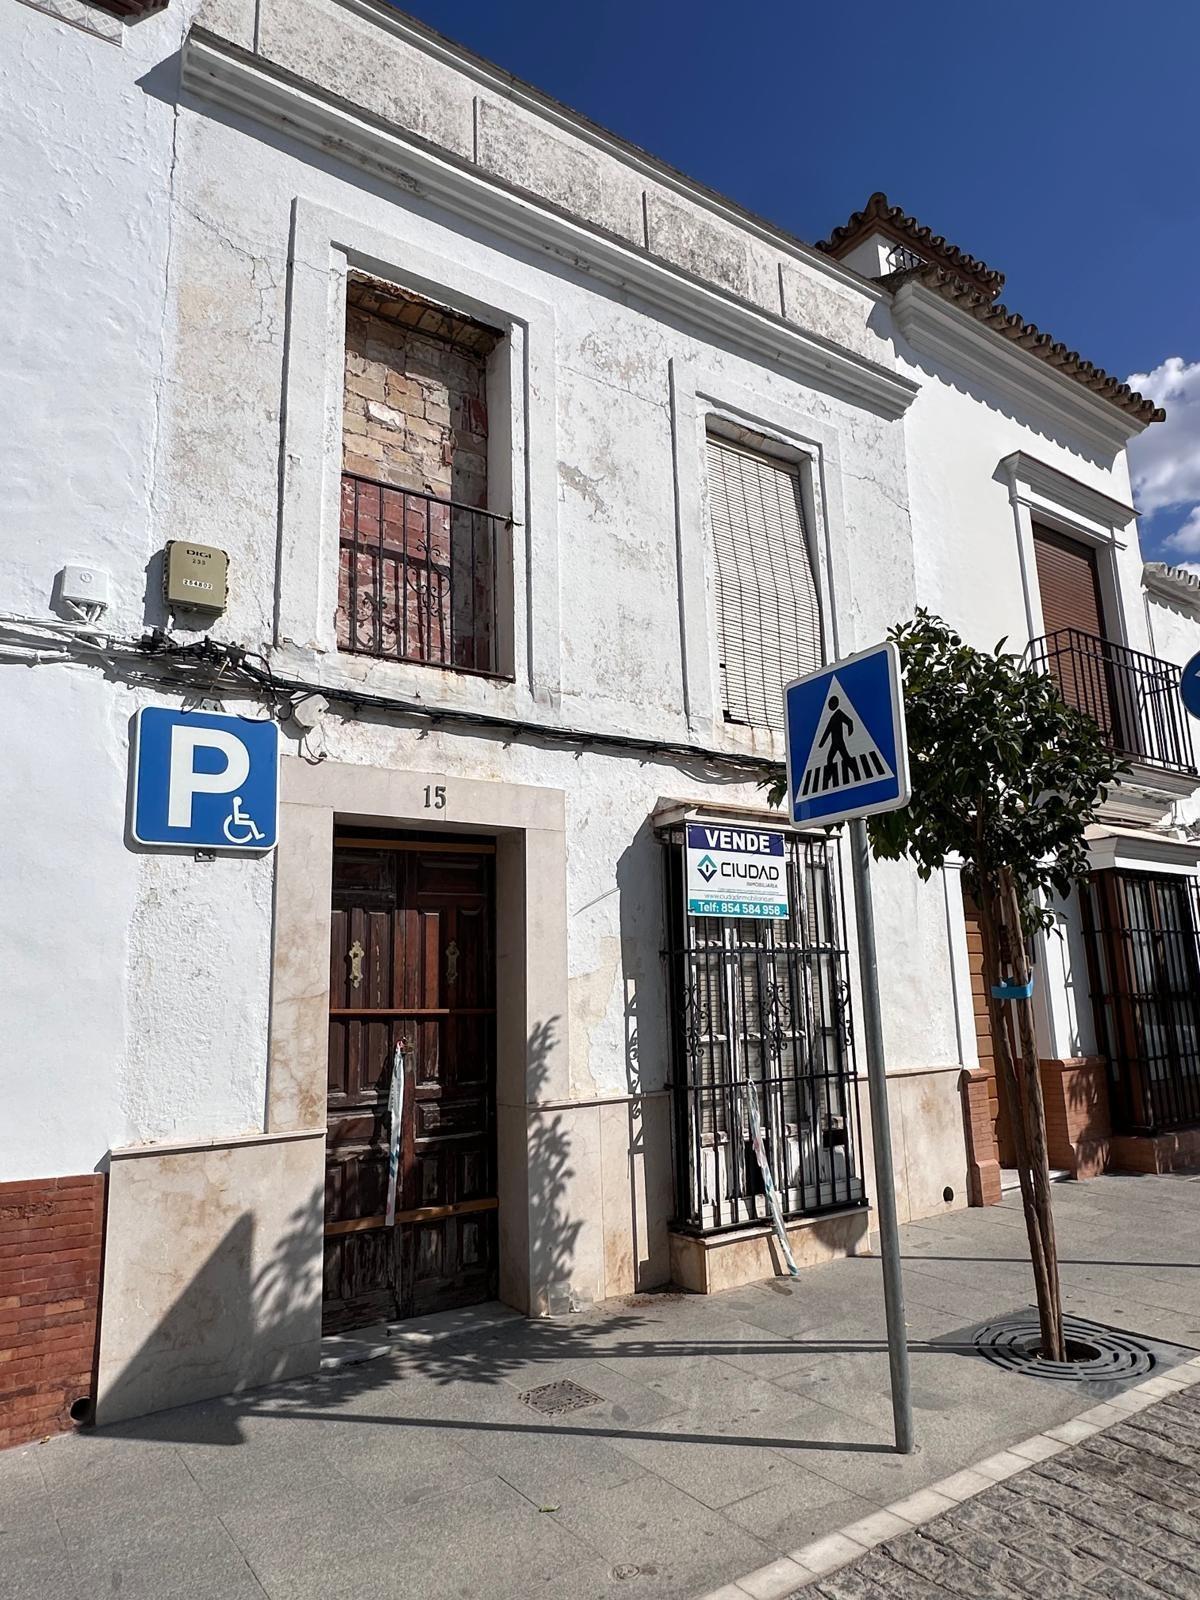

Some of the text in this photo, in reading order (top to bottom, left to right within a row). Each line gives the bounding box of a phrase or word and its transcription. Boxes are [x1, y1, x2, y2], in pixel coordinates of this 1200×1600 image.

[186, 549, 212, 559] DIGI
[168, 724, 250, 828] P
[423, 785, 447, 809] 15
[704, 828, 771, 853] VENDE
[720, 861, 780, 881] CIUDAD
[698, 901, 781, 916] Telf: 854 584 958
